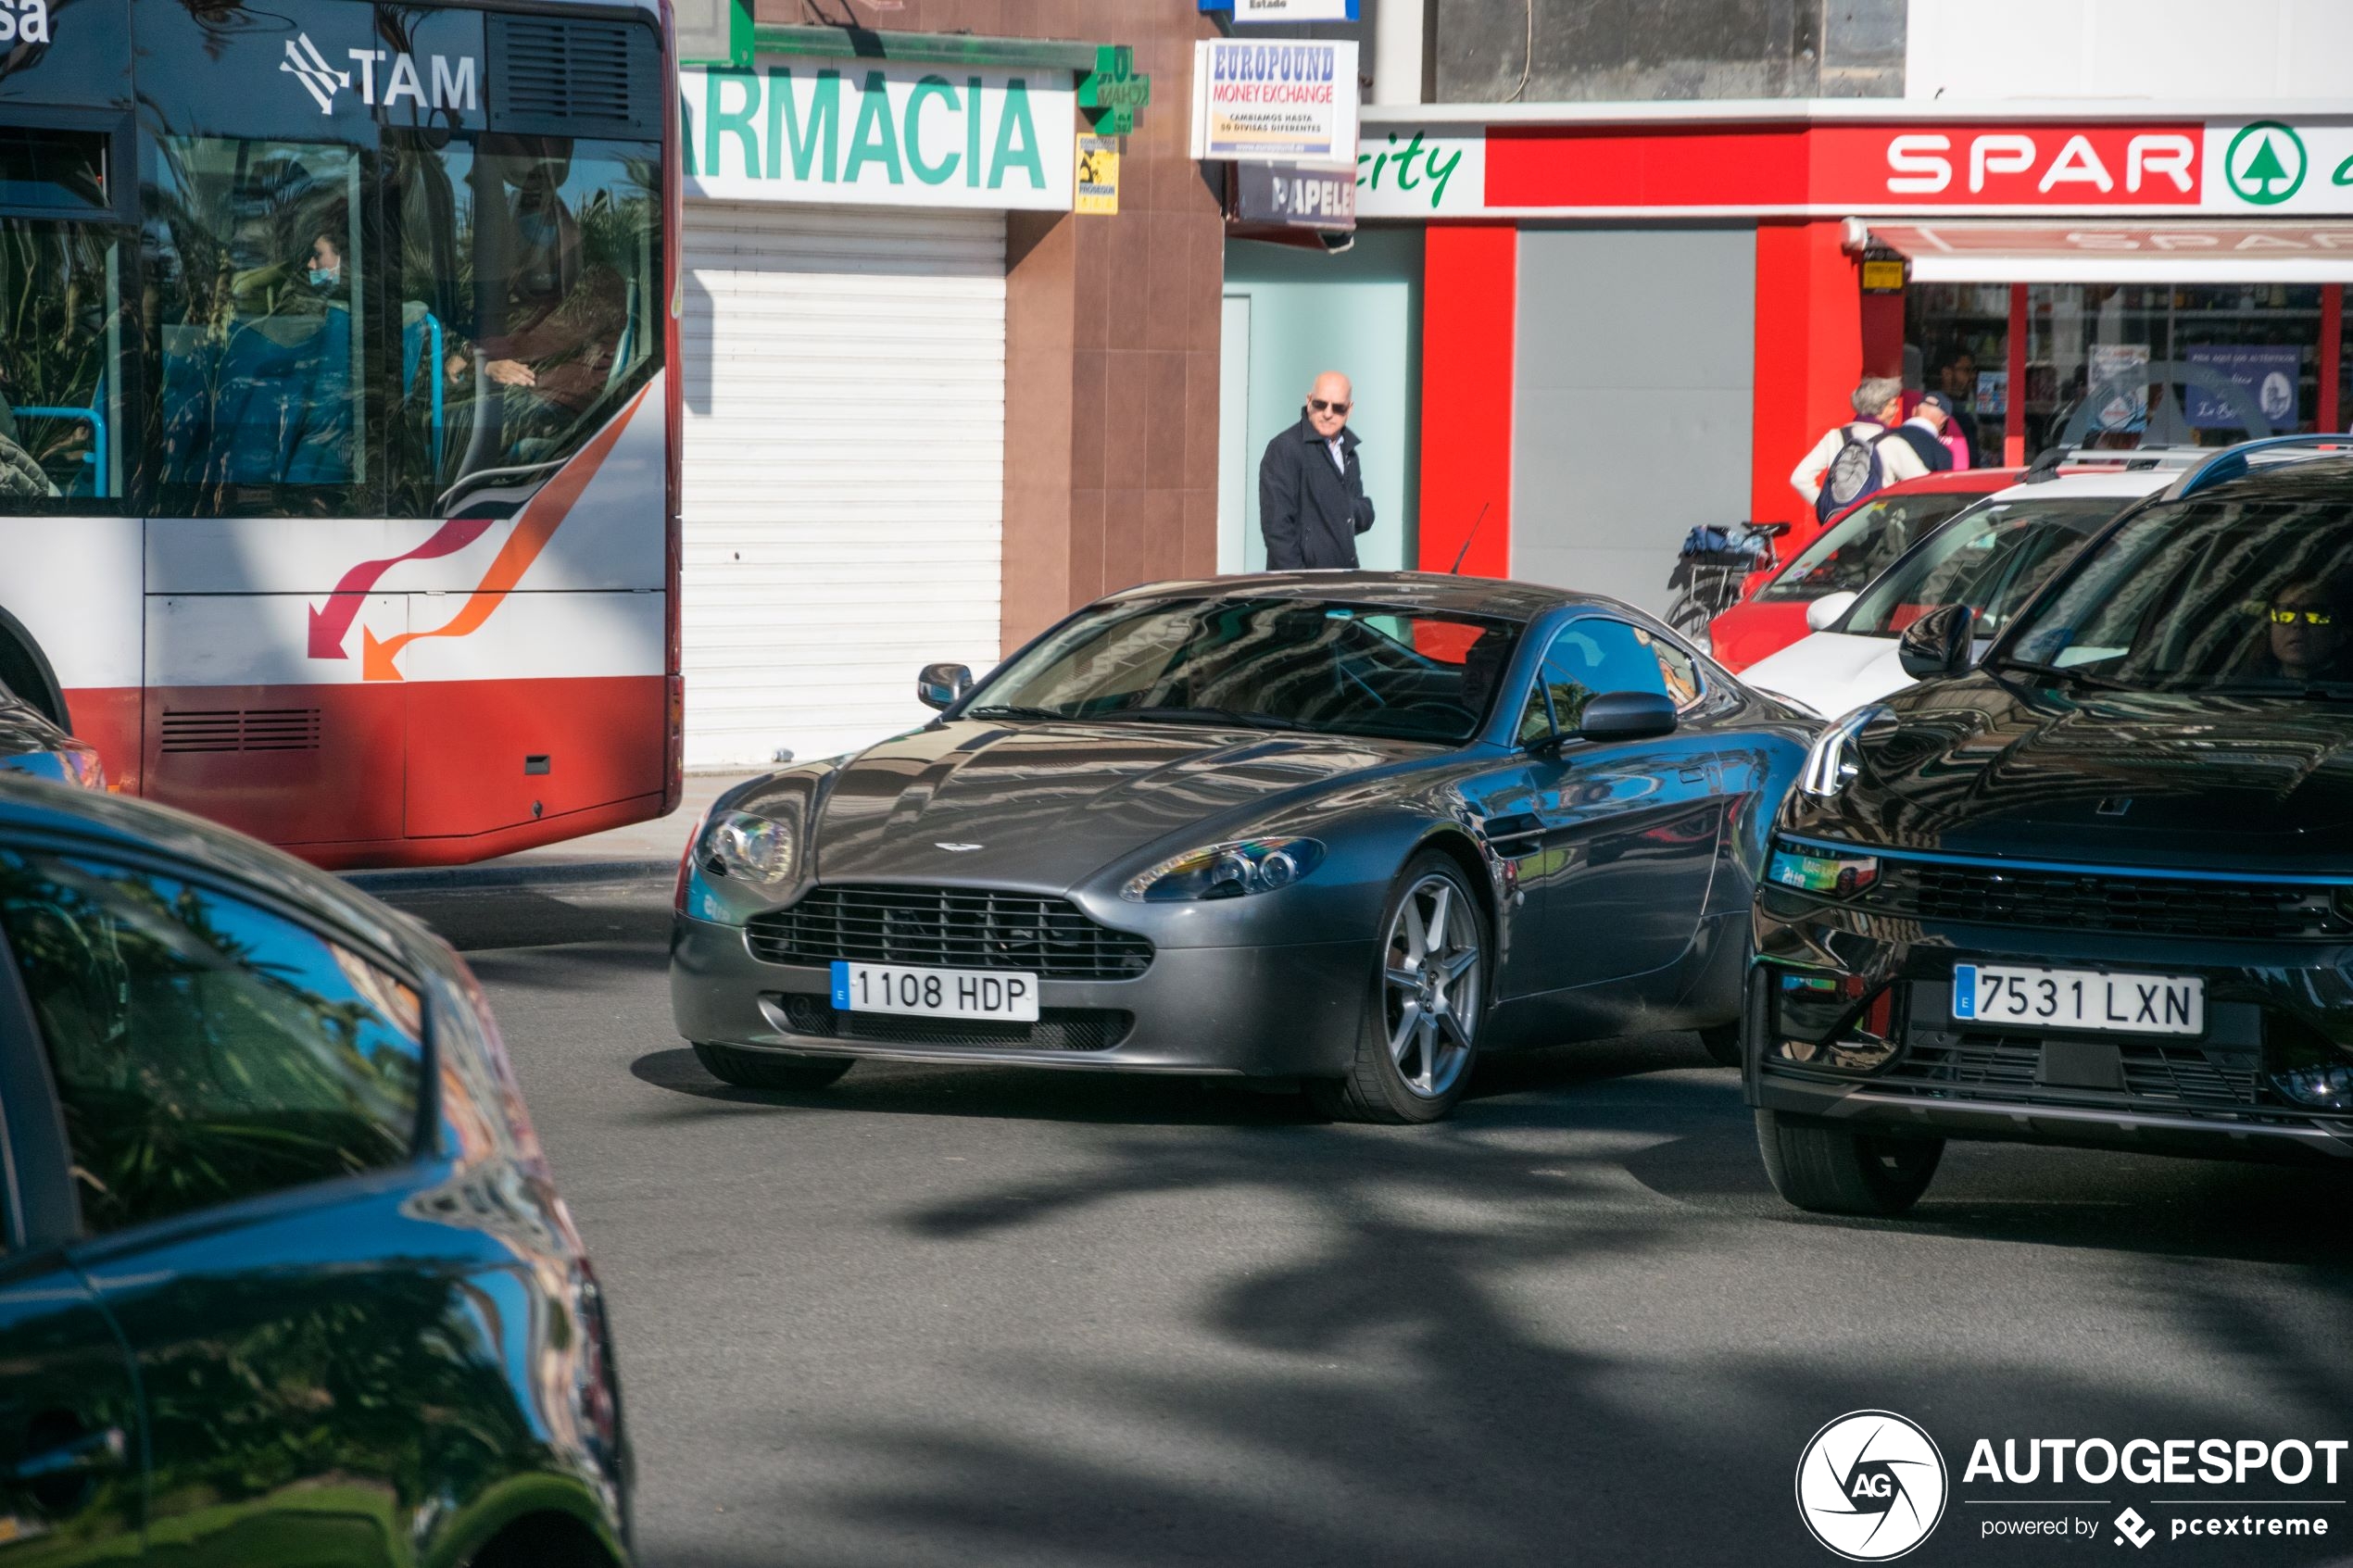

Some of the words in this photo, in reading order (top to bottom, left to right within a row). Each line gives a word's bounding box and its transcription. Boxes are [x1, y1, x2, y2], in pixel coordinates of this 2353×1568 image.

[1250, 0, 1287, 8] Estado
[349, 49, 476, 109] TAM
[1214, 45, 1334, 82] EUROPOUND
[1214, 83, 1260, 103] MONEY
[1264, 84, 1333, 104] EXCHANGE
[1229, 113, 1282, 122] CAMBIAMOS
[1285, 114, 1313, 122] HASTA
[1234, 123, 1268, 132] DIVISAS
[1271, 124, 1321, 133] DIFERENTES
[1886, 134, 2195, 194] SPAR
[860, 971, 942, 1008] 1108
[959, 976, 1026, 1012] HDP
[1961, 997, 1969, 1008] E
[1982, 974, 2082, 1019] 7531
[2107, 983, 2190, 1025] LXN
